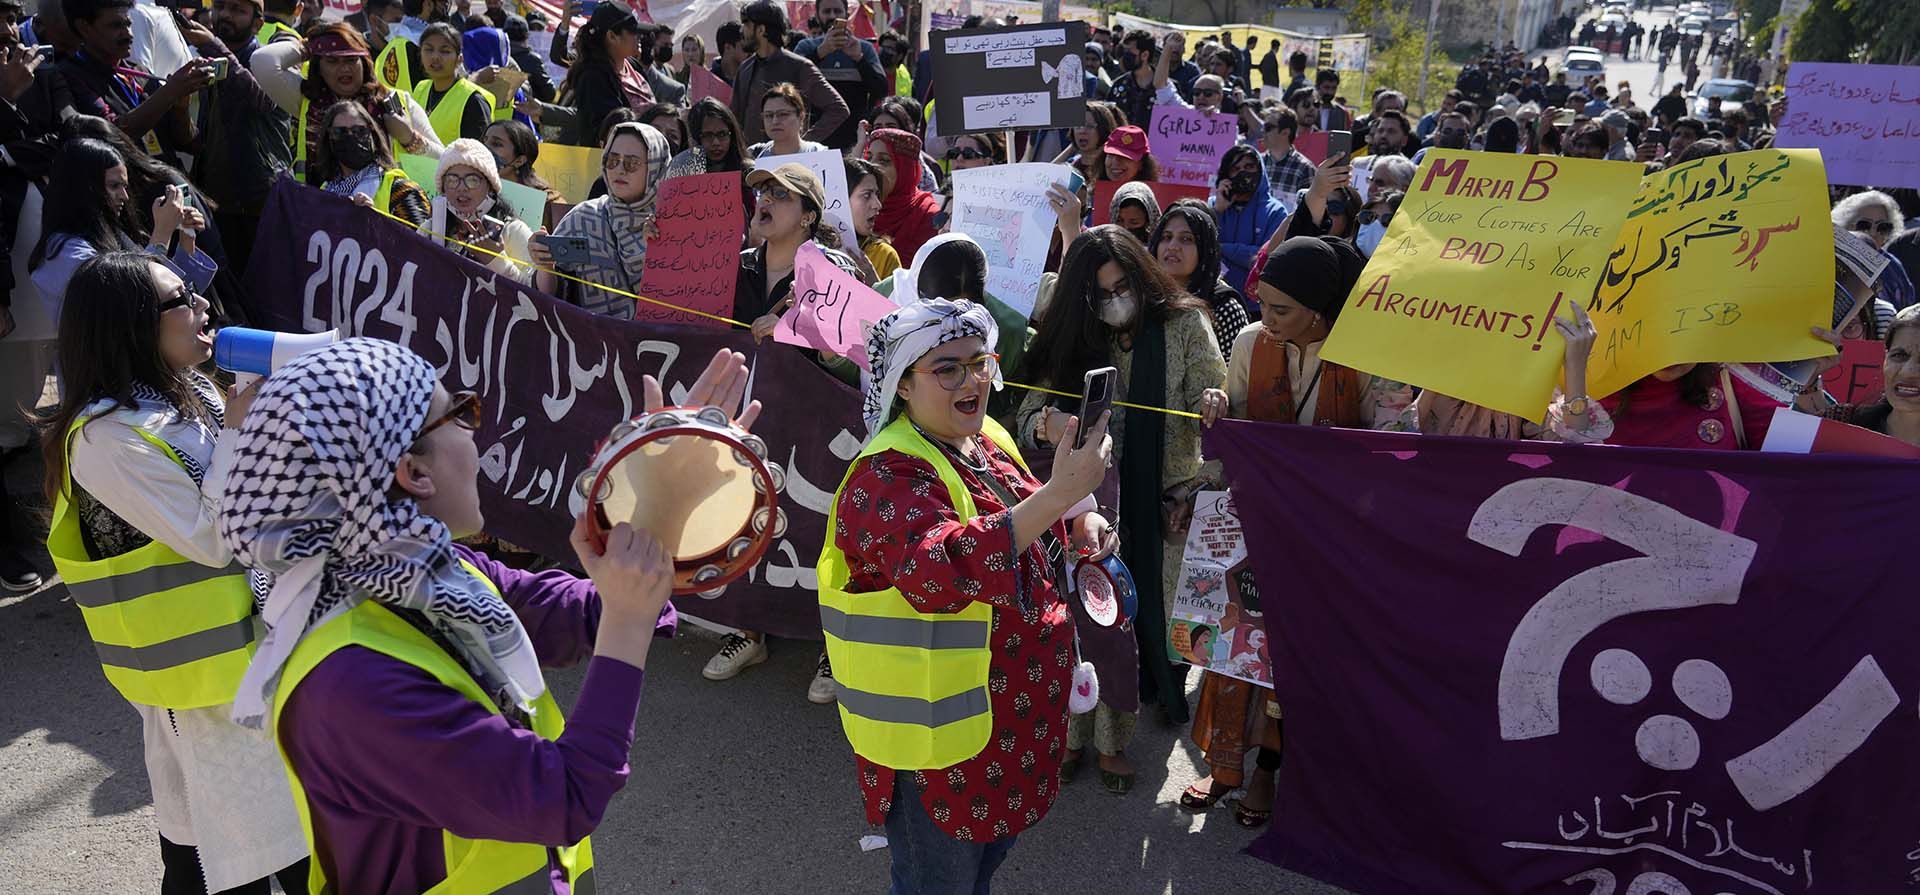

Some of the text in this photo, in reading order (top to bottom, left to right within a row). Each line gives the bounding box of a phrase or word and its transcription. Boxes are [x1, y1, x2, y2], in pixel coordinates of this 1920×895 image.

[1158, 114, 1231, 138] GIRLS JUST
[1180, 143, 1216, 156] WANNA
[1419, 158, 1559, 202] MARIA B
[1416, 200, 1603, 238] YOUR CLOTHES ARE
[1395, 235, 1591, 279] AS BAD AS YOUR
[302, 229, 419, 348] 2024
[1356, 273, 1564, 351] ARGUMENTS!
